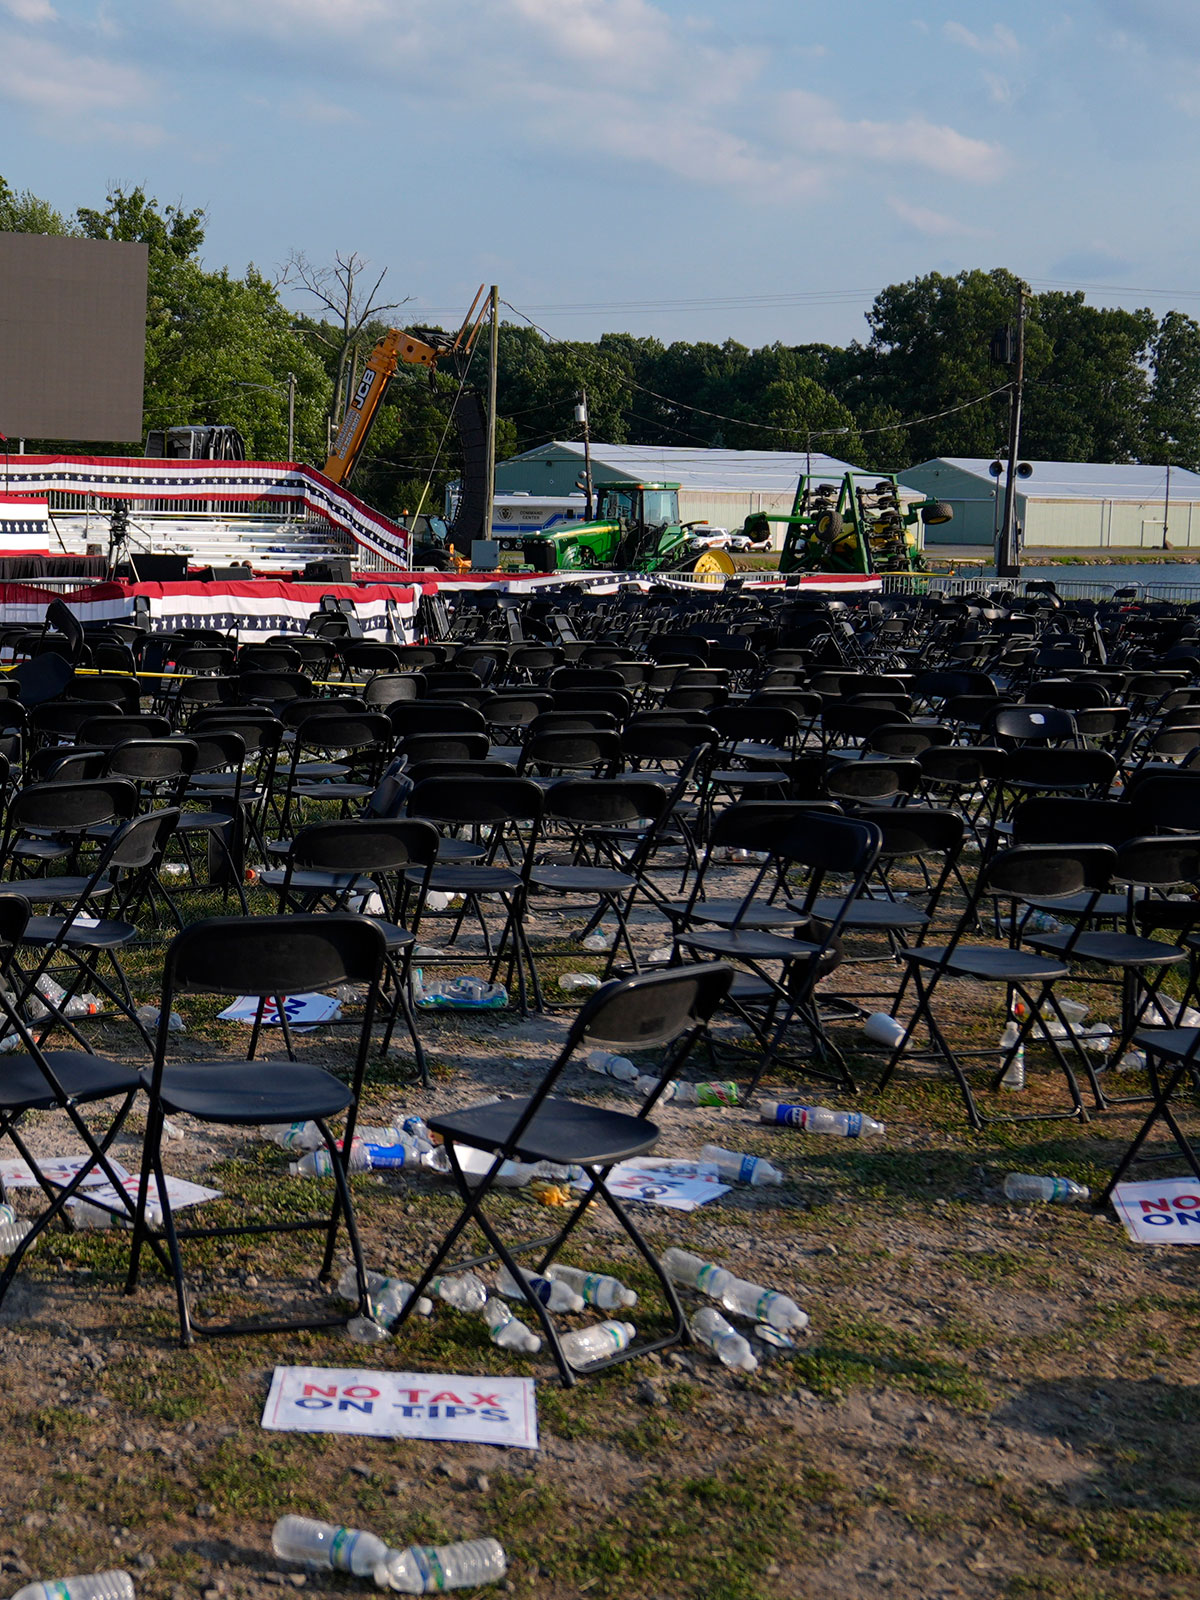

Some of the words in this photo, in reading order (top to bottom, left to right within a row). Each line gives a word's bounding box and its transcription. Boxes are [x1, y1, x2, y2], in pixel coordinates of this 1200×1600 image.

[355, 369, 376, 409] JCB
[1139, 1195, 1200, 1213] NO
[302, 1384, 381, 1399] NO
[398, 1389, 503, 1408] TAX
[294, 1398, 374, 1415] ON
[392, 1404, 510, 1423] TIPS
